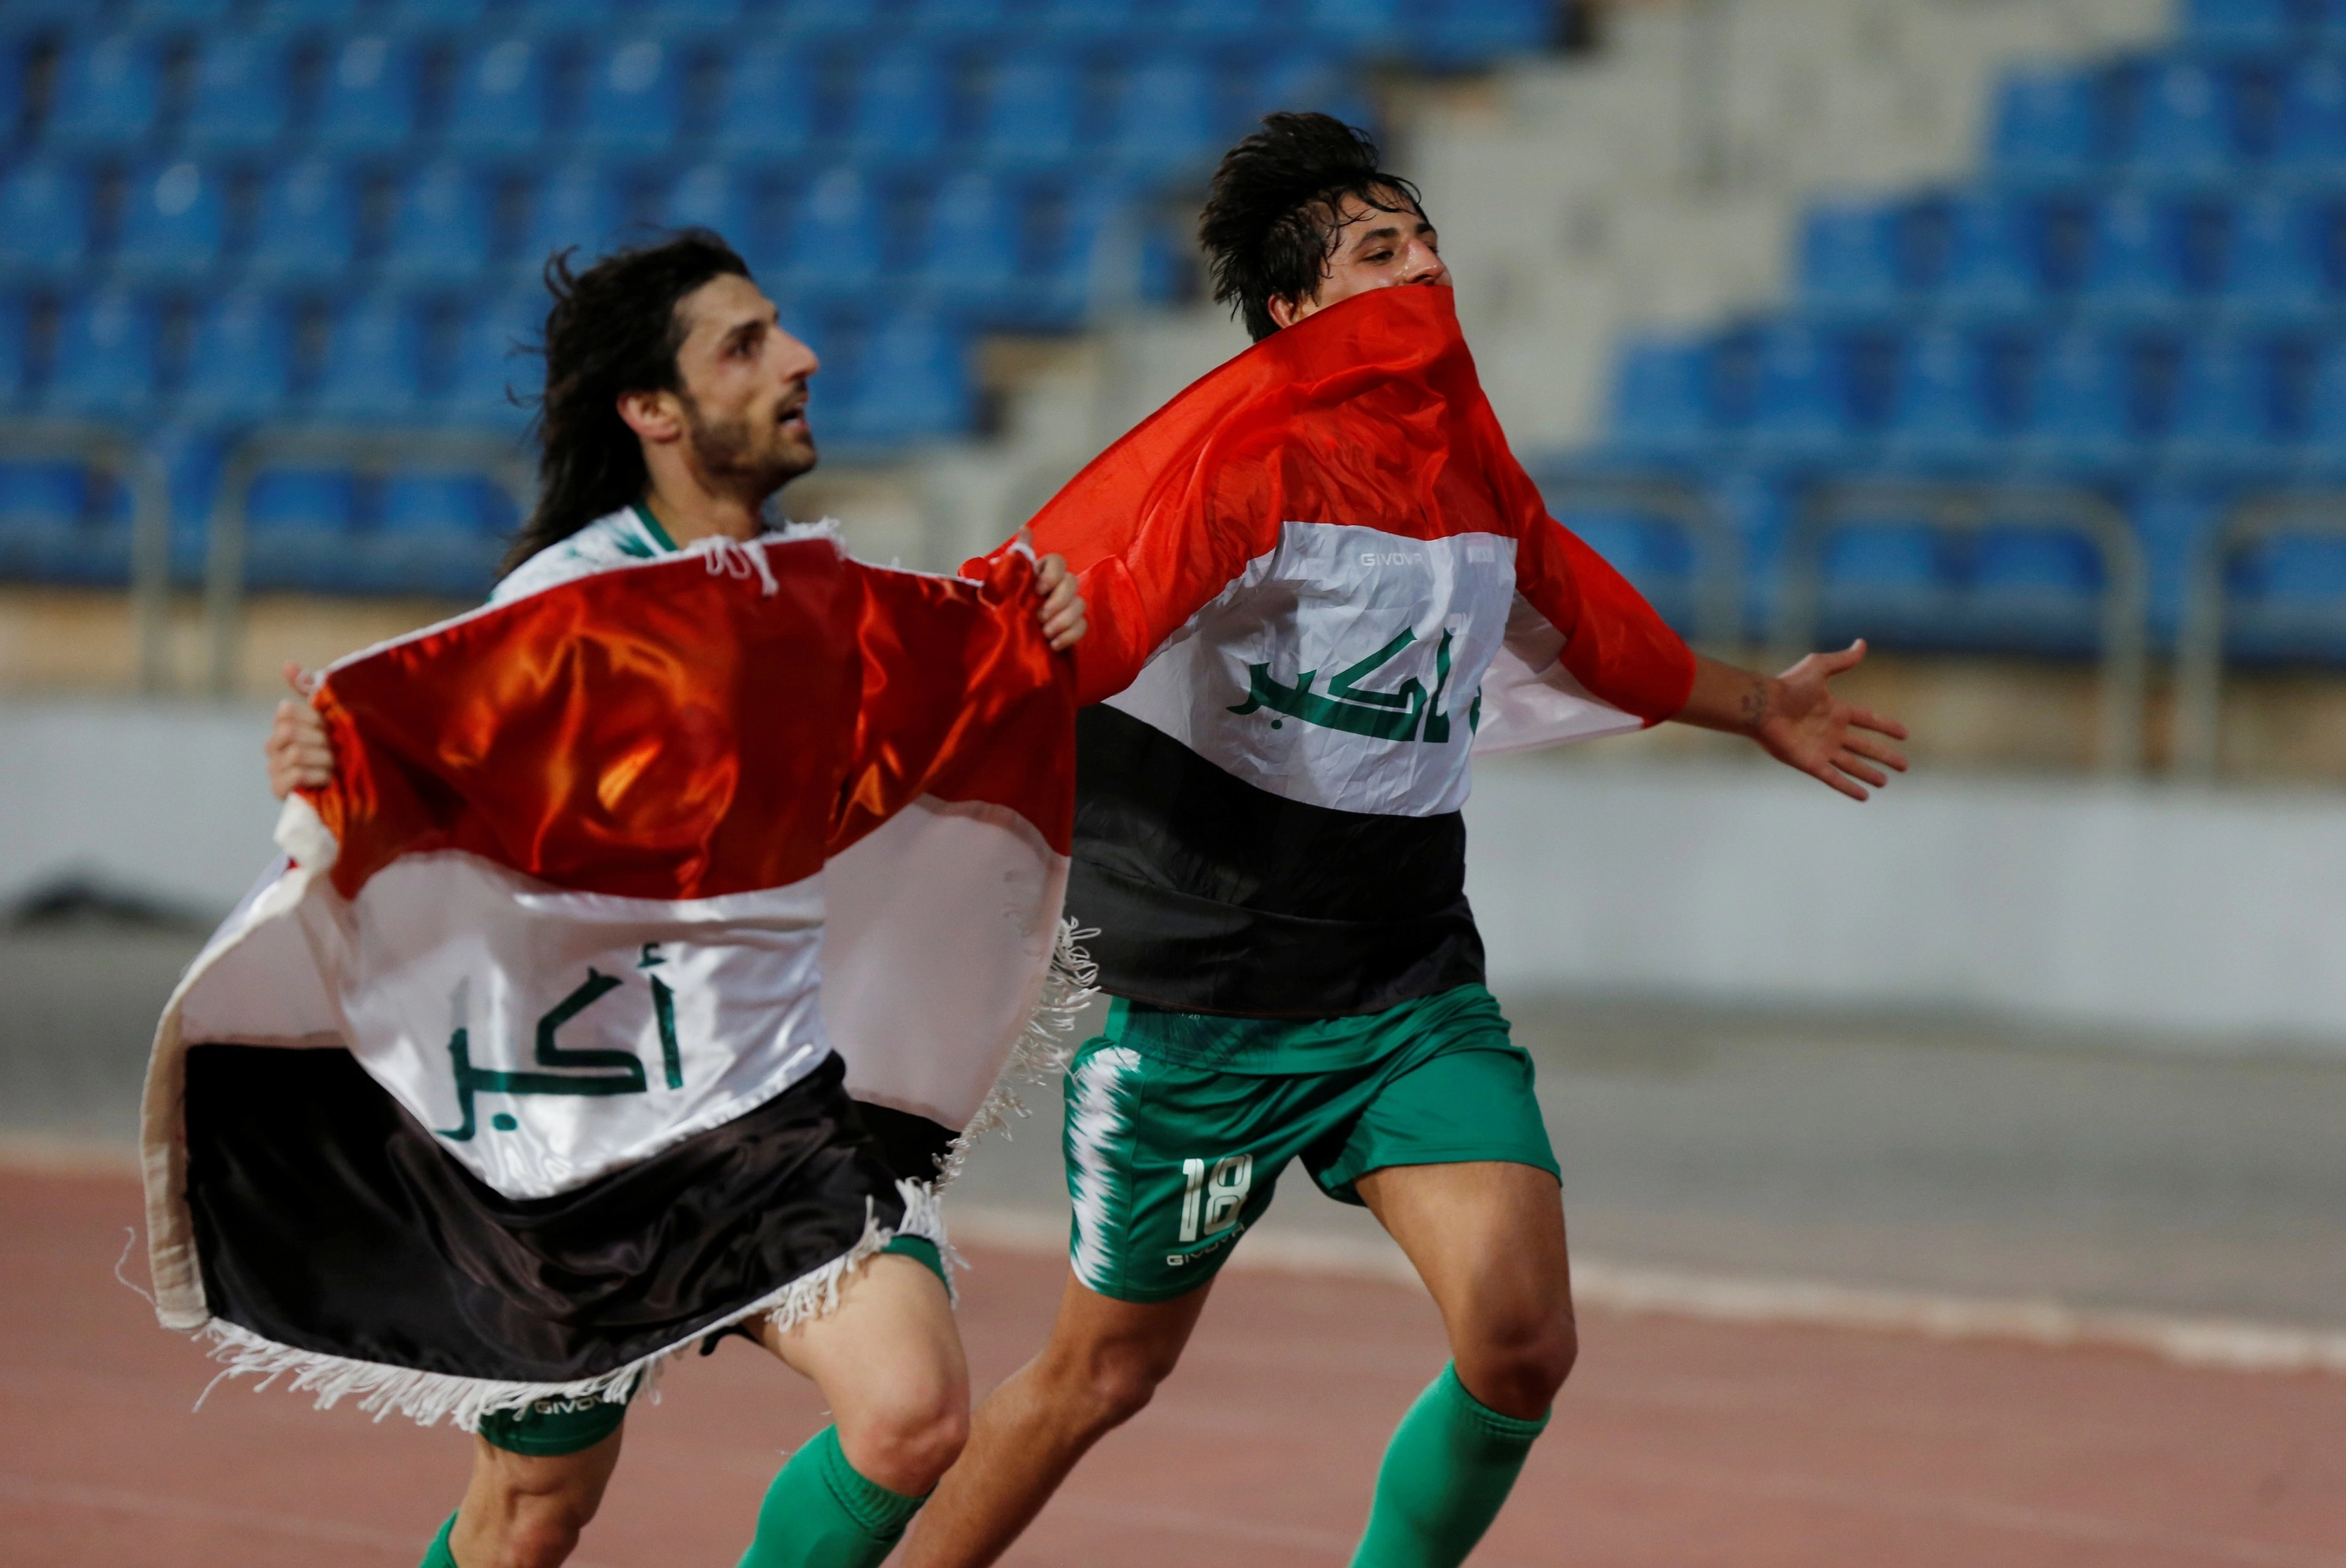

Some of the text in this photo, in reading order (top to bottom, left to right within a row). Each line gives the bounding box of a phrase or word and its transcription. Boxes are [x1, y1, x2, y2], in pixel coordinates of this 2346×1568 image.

[1179, 1153, 1253, 1242] 18
[1166, 1222, 1245, 1266] GIVO
[534, 1394, 604, 1415] GIVO
